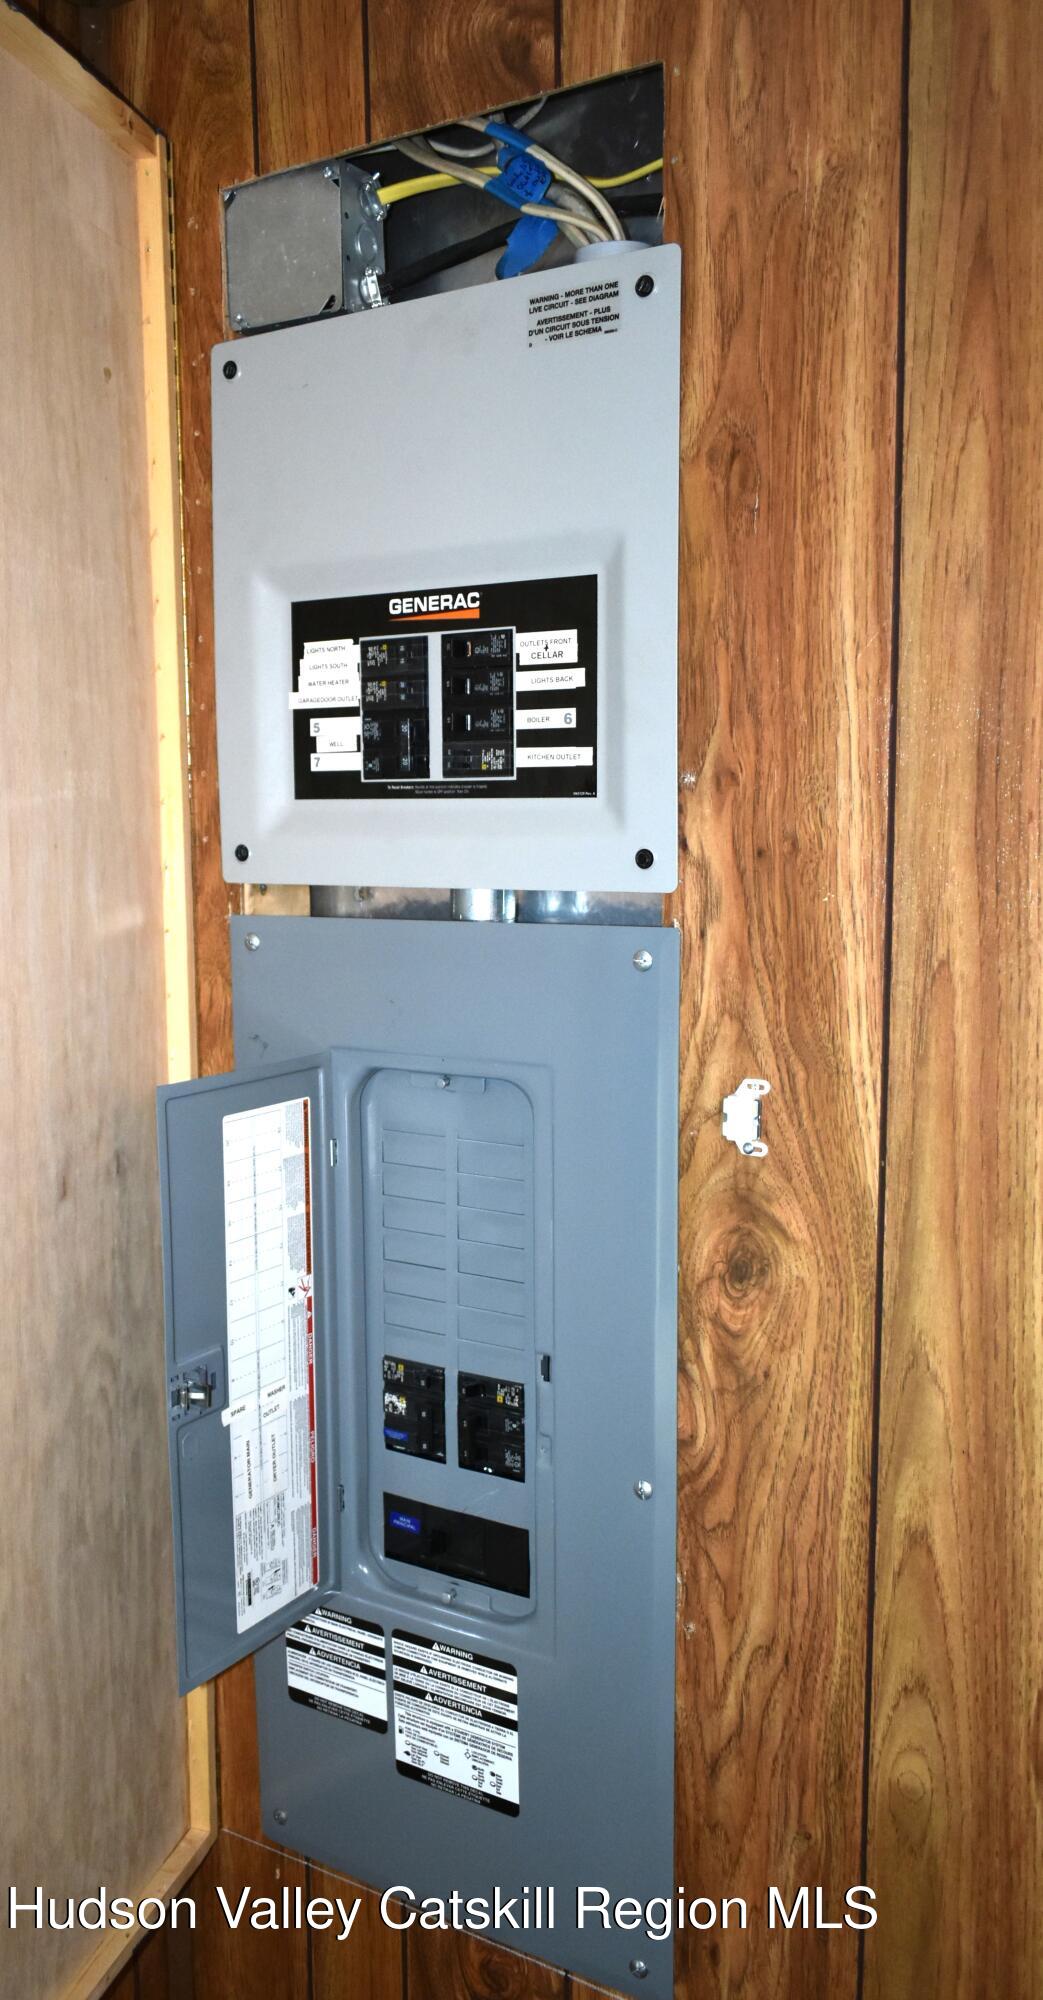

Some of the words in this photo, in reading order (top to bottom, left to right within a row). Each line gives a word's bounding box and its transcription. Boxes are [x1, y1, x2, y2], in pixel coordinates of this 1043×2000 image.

[529, 294, 559, 305] WARNING
[564, 288, 584, 298] MORE
[585, 284, 603, 294] THAN
[604, 281, 619, 290] ONE
[528, 306, 542, 314] LIVE
[543, 300, 569, 311] CIRCUIT
[574, 297, 587, 305] SEE
[588, 290, 619, 302] DIAGRAM
[536, 310, 588, 326] AVERTISSEMENT
[593, 306, 611, 314] PLUS
[528, 328, 544, 337] D'UN
[545, 323, 571, 333] CIRCUIT
[572, 319, 590, 328] SOUS
[591, 313, 620, 324] TENSION
[548, 333, 564, 342] VOIR
[574, 326, 602, 337] SCHEMA
[388, 591, 480, 615] GENERAC
[550, 637, 572, 645] FRONT
[306, 647, 325, 655] LIGHTS
[326, 645, 346, 653] NORTH
[530, 650, 564, 660] CELLAR
[555, 675, 574, 683] BACK
[563, 712, 573, 725] 6
[313, 722, 320, 733] 5
[313, 757, 320, 767] 7
[527, 753, 555, 761] KITCHEN
[556, 753, 581, 761] OUTLET
[230, 1404, 246, 1417] SPARE
[263, 1404, 280, 1418] OUTLET
[321, 1609, 352, 1625] WARNING
[312, 1628, 365, 1650] AVERTISSEMENT
[316, 1648, 361, 1670] ADVERTENCIA
[440, 1644, 474, 1661] WARNING
[428, 1668, 487, 1693] AVERTISSEMENT
[433, 1695, 483, 1717] ADVERTENCIA
